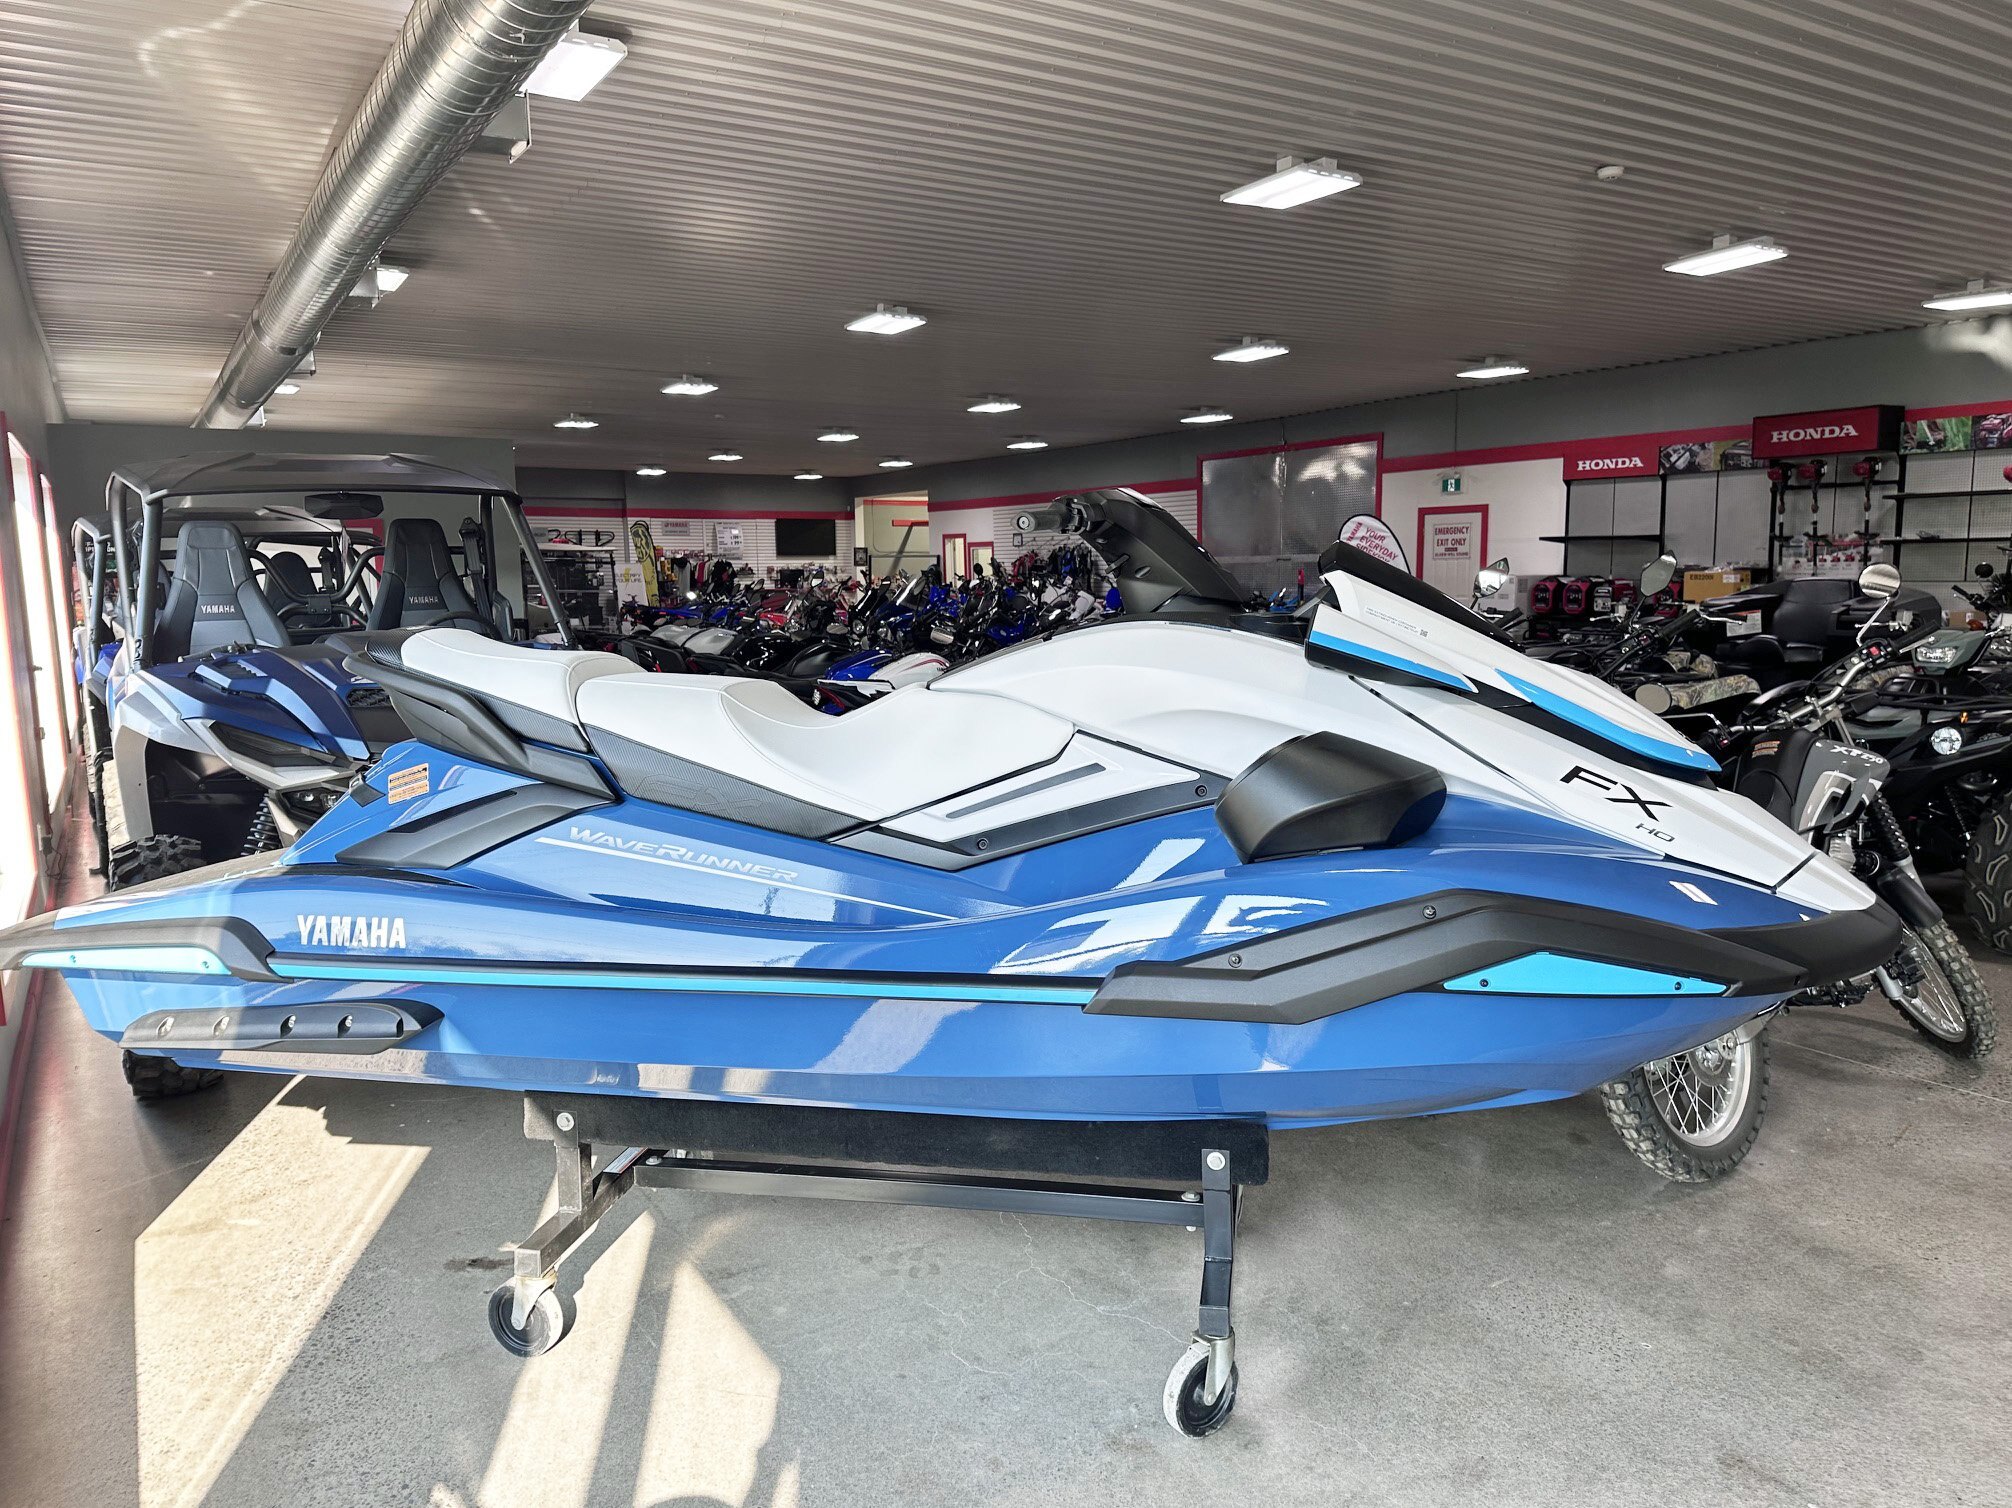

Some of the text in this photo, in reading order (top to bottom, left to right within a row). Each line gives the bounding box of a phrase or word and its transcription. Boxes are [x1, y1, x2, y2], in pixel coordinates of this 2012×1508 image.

[1770, 424, 1859, 443] HONDA
[1576, 457, 1643, 471] HONDA
[1346, 522, 1363, 542] YAMAHA
[1364, 527, 1386, 544] YOUR
[1434, 526, 1469, 536] EMERGENCY
[1360, 535, 1399, 561] EVERYDAY
[1436, 538, 1467, 547] EXIT ONLY
[201, 604, 235, 614] YAMAHA
[408, 595, 439, 604] YAMAHA
[1830, 744, 1884, 764] XT250
[1559, 765, 1674, 822] FX
[1635, 823, 1676, 842] HO
[297, 914, 406, 949] YAMAHA
